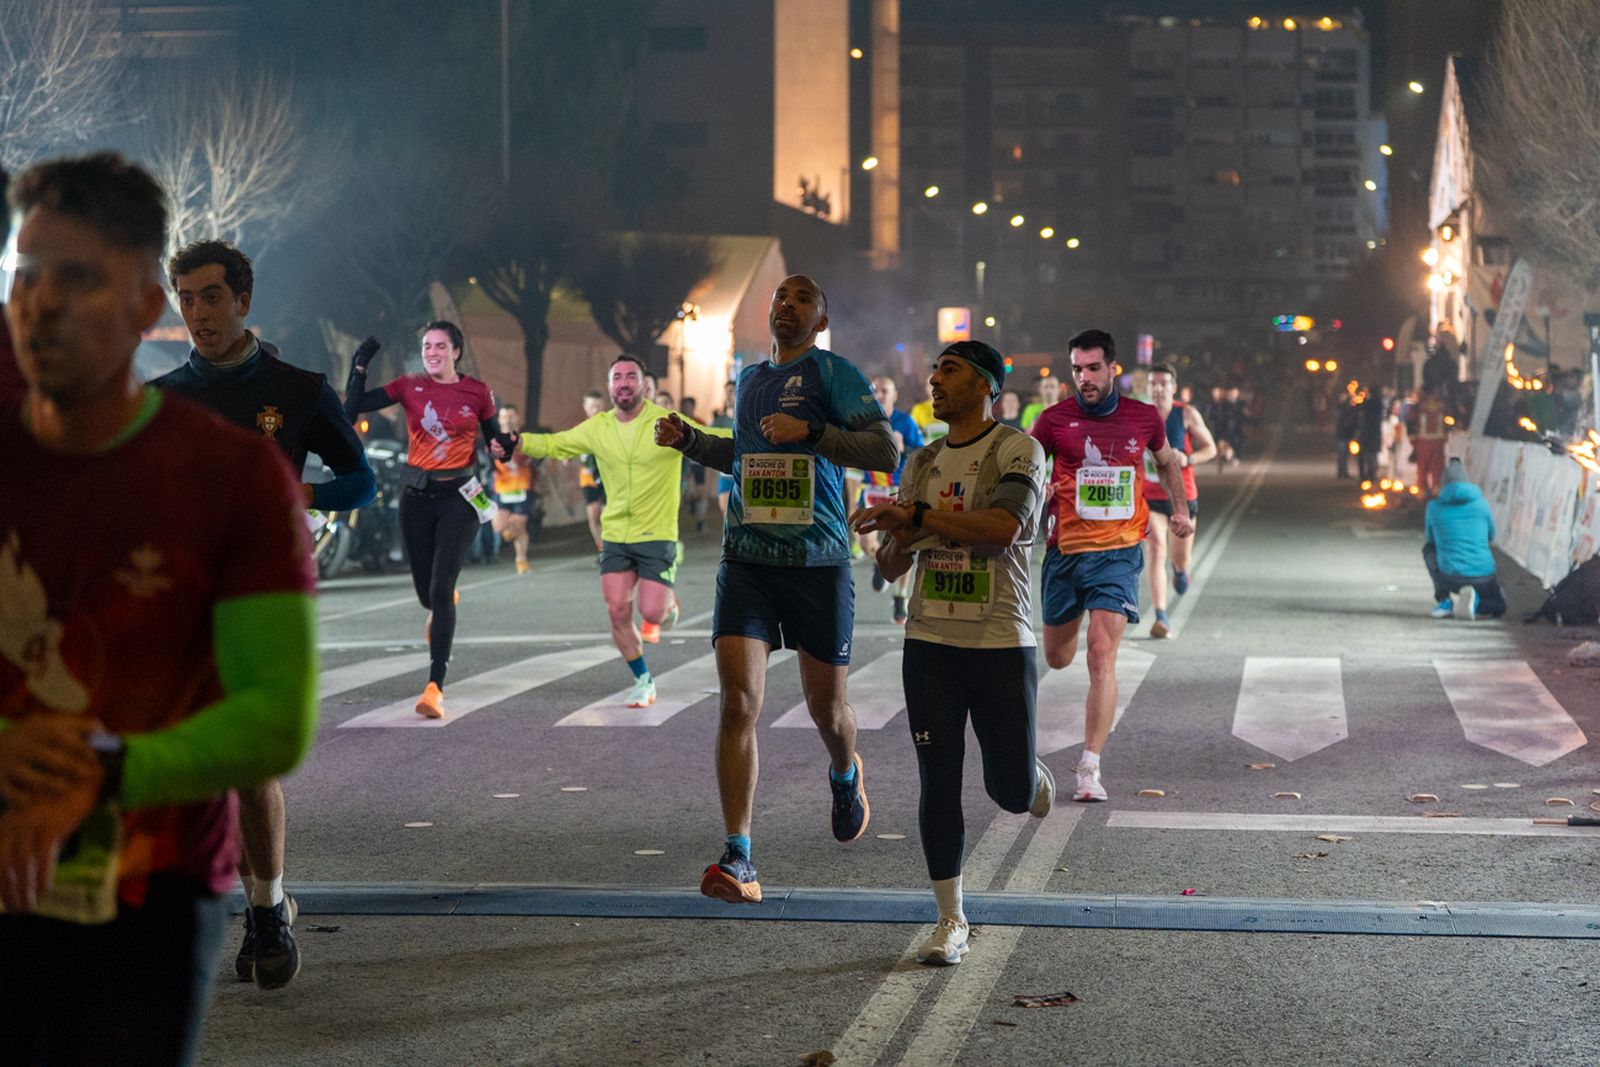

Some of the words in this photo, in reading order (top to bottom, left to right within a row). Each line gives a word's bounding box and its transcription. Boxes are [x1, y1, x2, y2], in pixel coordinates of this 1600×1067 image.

[756, 461, 775, 469] NOCHE
[777, 461, 785, 469] DE
[748, 469, 761, 477] SAN
[751, 478, 801, 500] 8695
[934, 571, 976, 595] 9118
